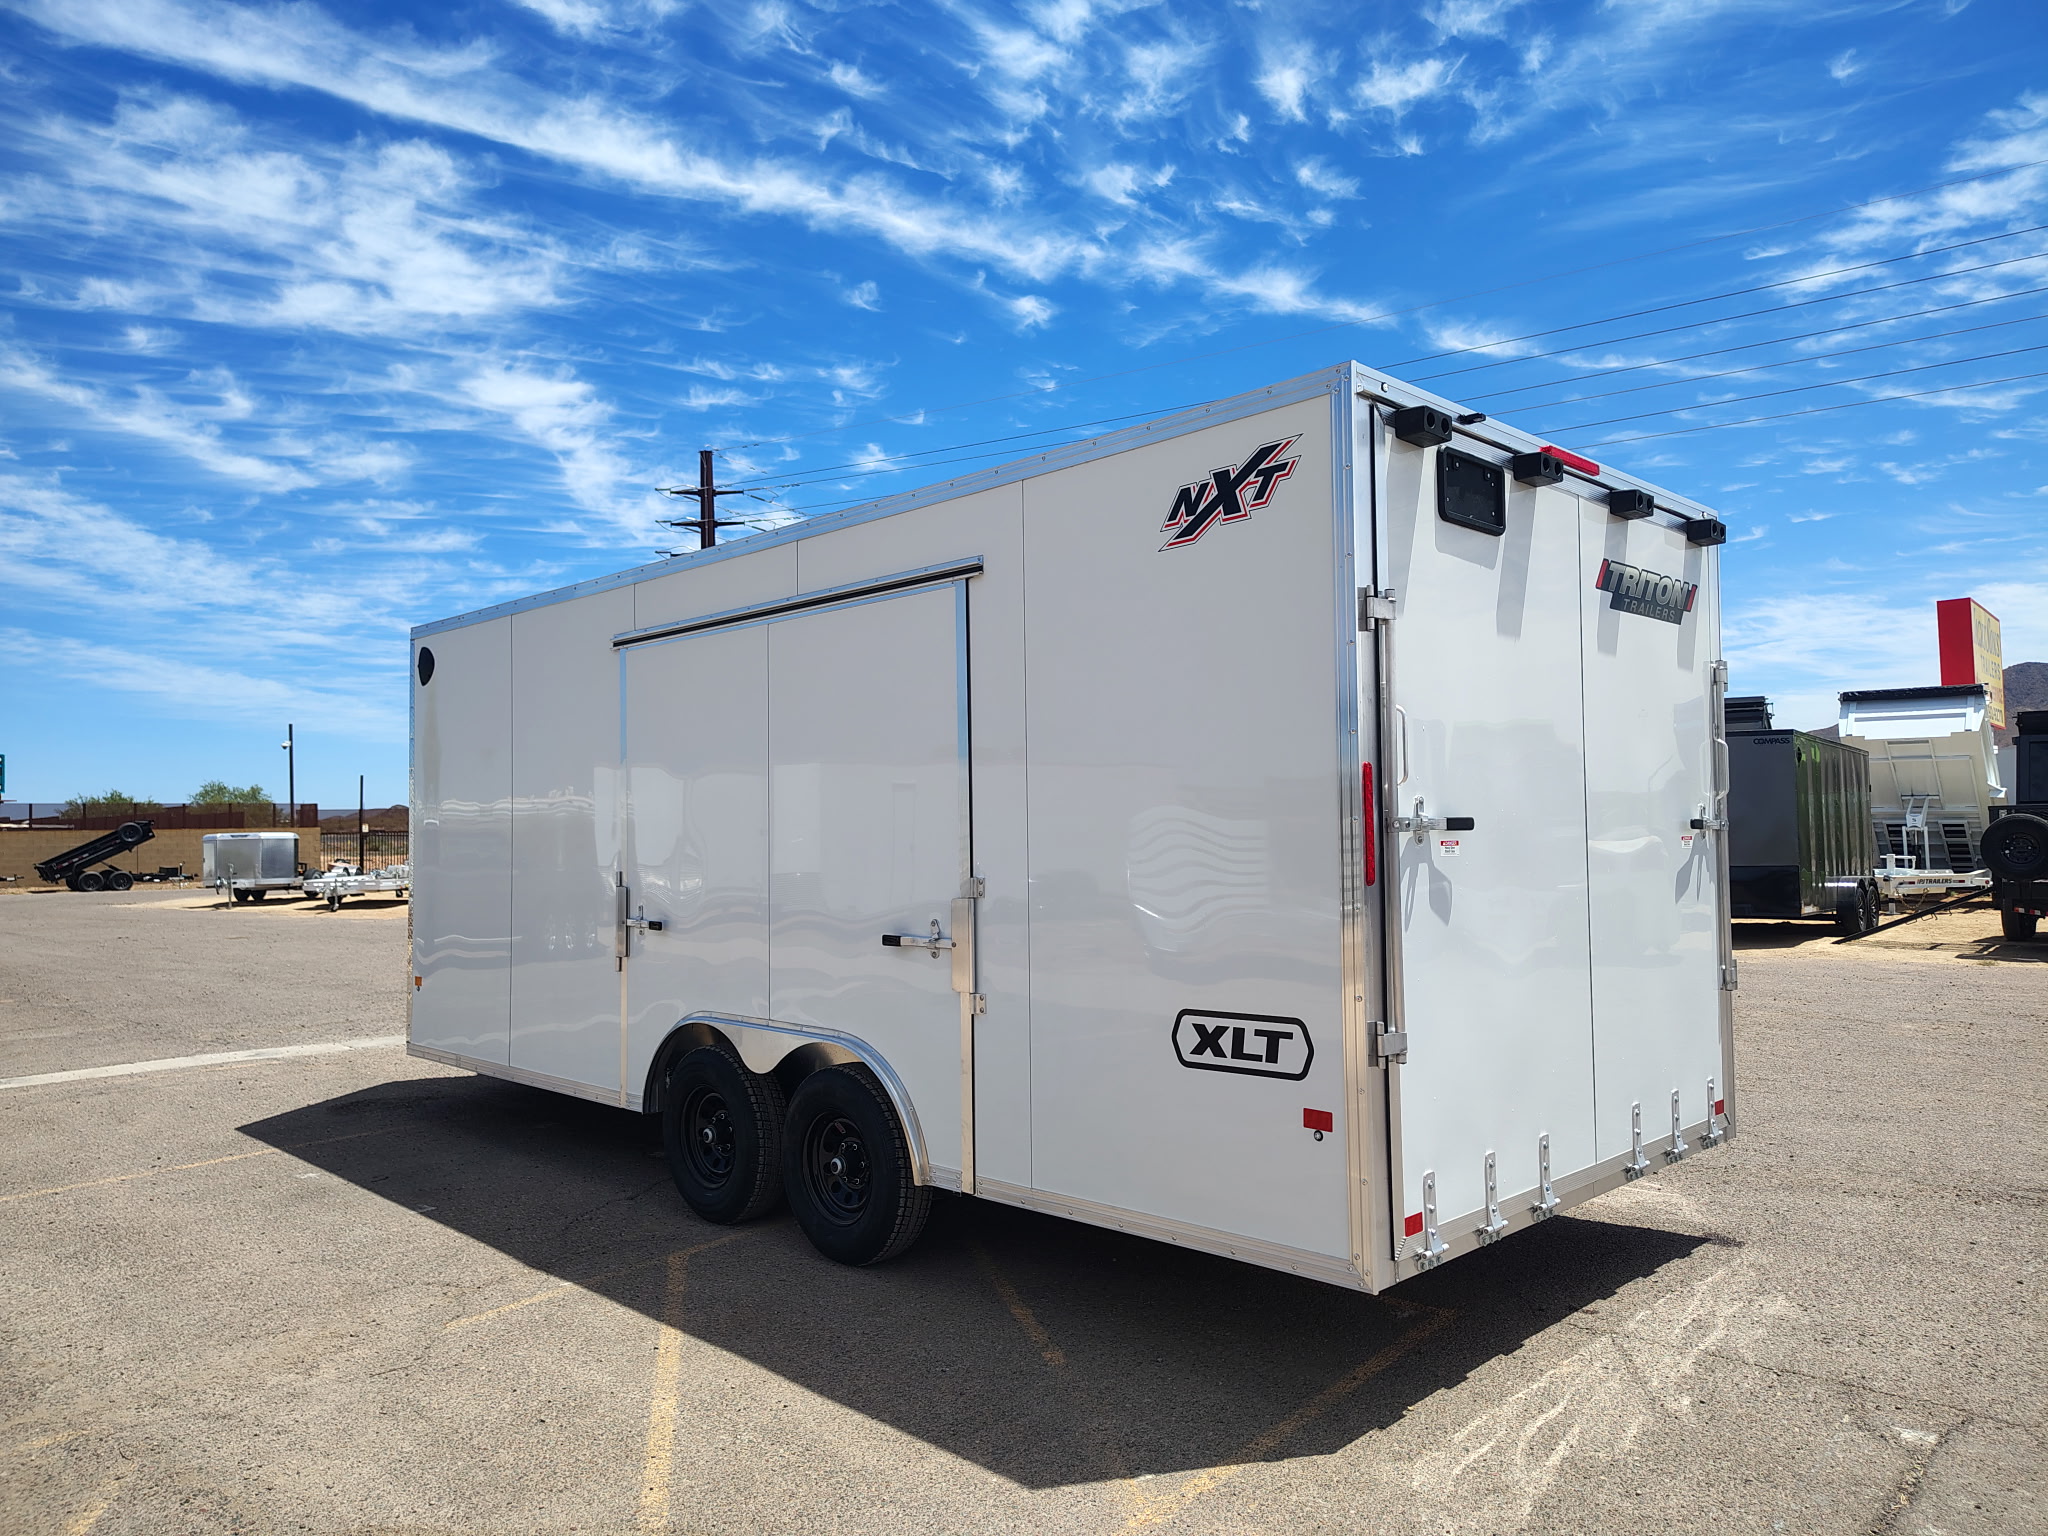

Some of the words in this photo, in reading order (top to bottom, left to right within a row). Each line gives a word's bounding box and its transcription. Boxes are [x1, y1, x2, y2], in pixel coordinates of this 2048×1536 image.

[1160, 436, 1301, 550] NXT
[1608, 562, 1689, 610] TRITON
[1623, 598, 1676, 622] TRAILERS
[1190, 1023, 1293, 1064] XLT
